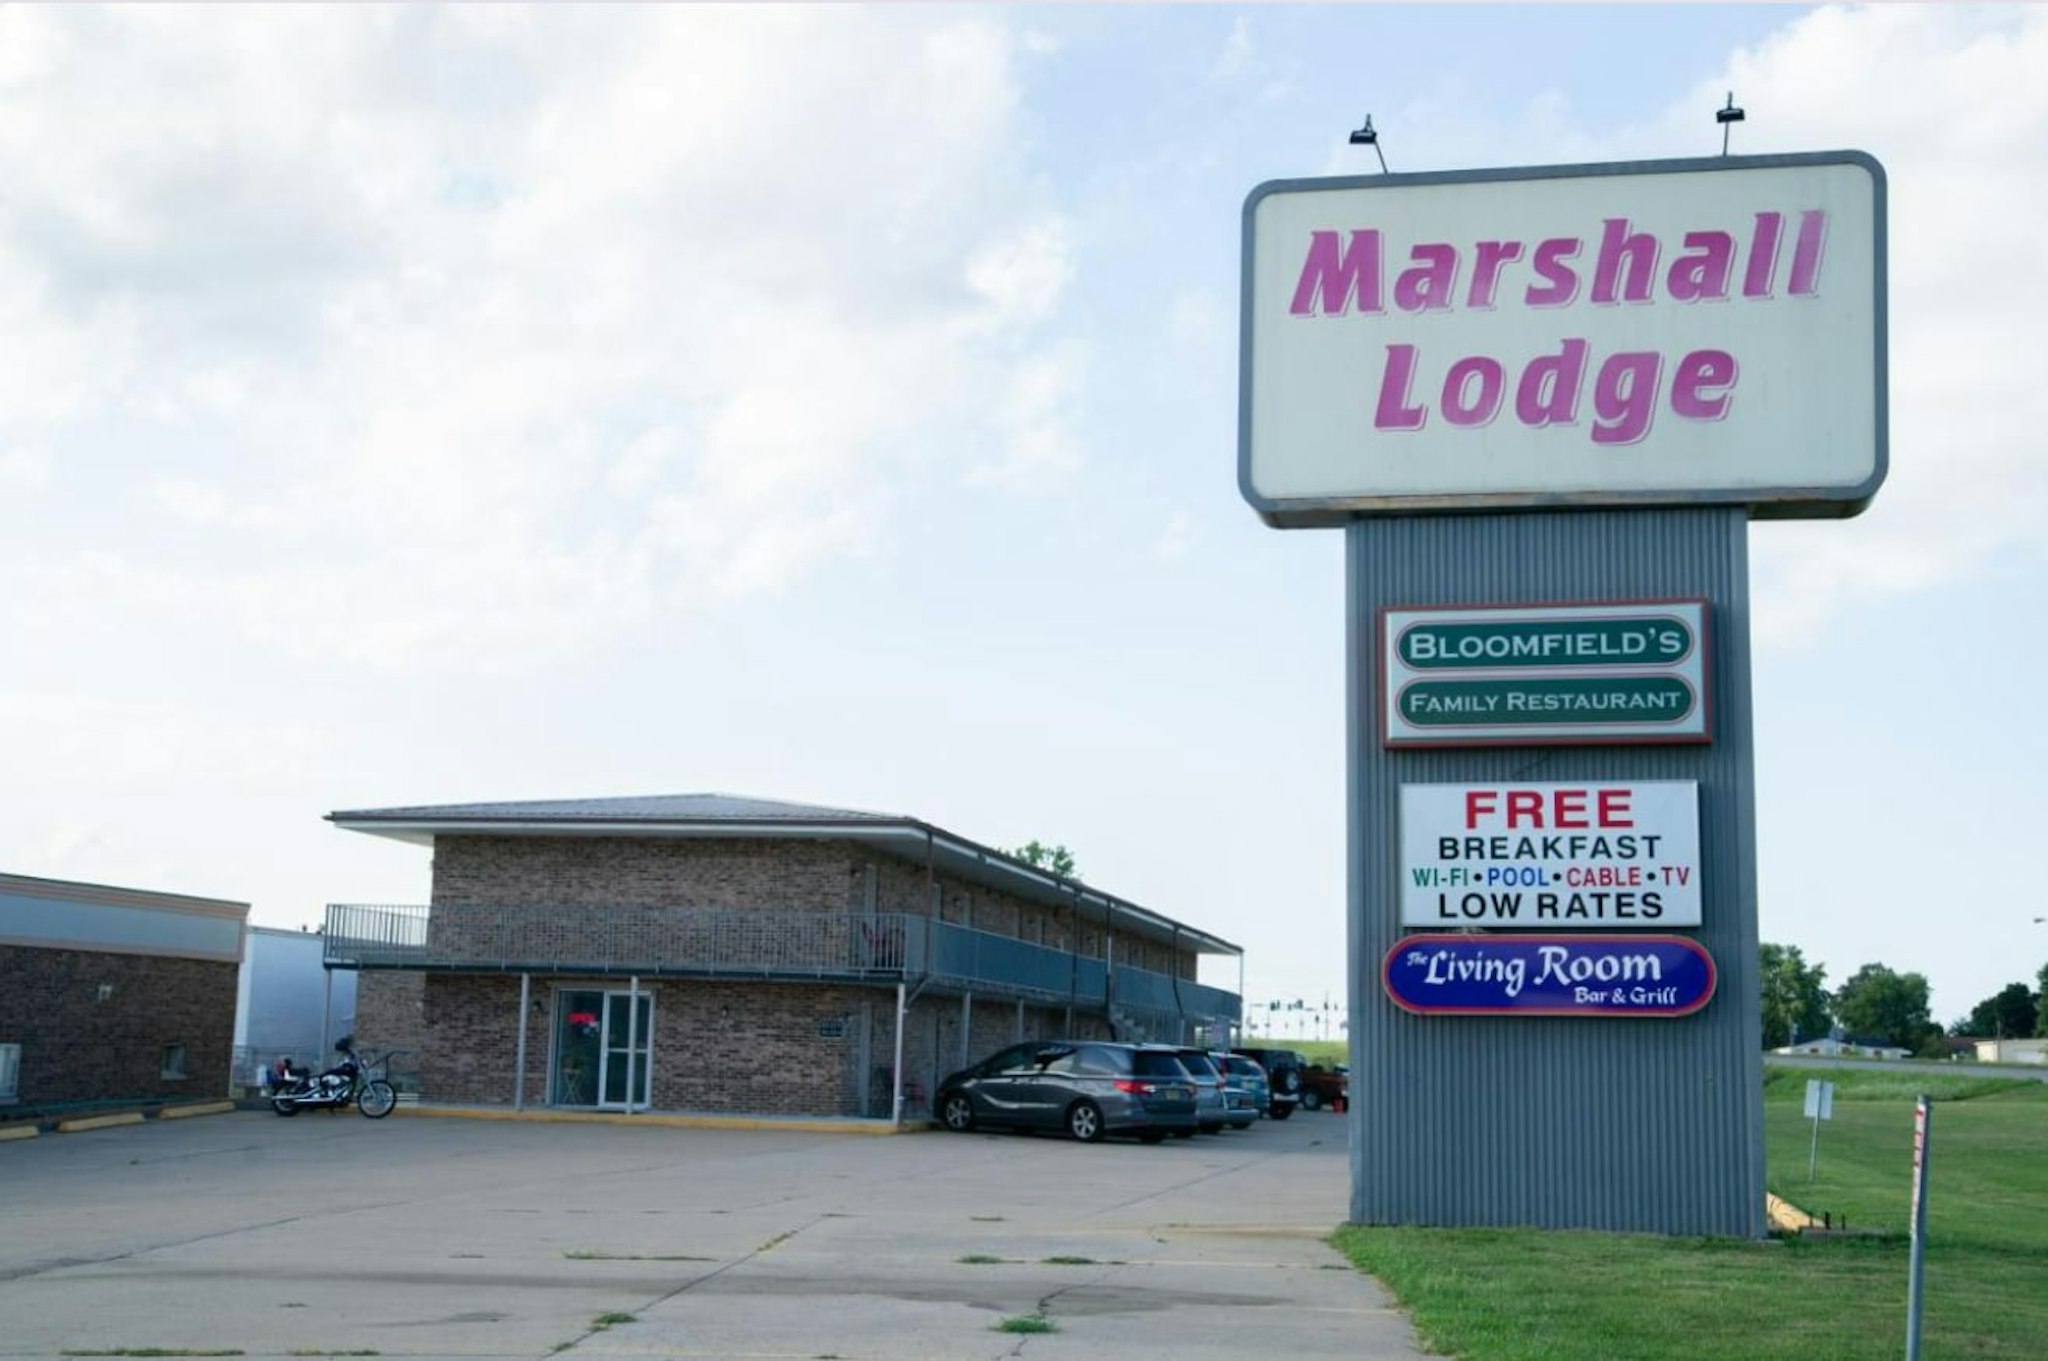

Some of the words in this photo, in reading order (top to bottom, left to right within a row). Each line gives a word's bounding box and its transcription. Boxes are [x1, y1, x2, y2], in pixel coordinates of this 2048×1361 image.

[1289, 209, 1826, 317] Marshall
[1373, 338, 1739, 445] Lodge
[1409, 627, 1682, 660] BLOOMFIELD'S
[1409, 694, 1499, 713] FAMILY
[1507, 691, 1681, 711] RESTAURANT
[1465, 789, 1634, 829] FREE
[1439, 836, 1662, 860] BREAKFAST
[1412, 867, 1468, 887] WI-FI
[1487, 867, 1549, 886] POOL
[1566, 866, 1641, 886] CABLE
[1661, 866, 1690, 885] TV
[1439, 893, 1522, 919] LOW
[1537, 892, 1663, 919] RATES
[1406, 951, 1429, 966] The
[1424, 950, 1526, 997] Living
[1533, 946, 1662, 986] Room
[1574, 986, 1608, 1004] Bar
[1611, 987, 1626, 1004] &
[1630, 986, 1678, 1005] Grill
